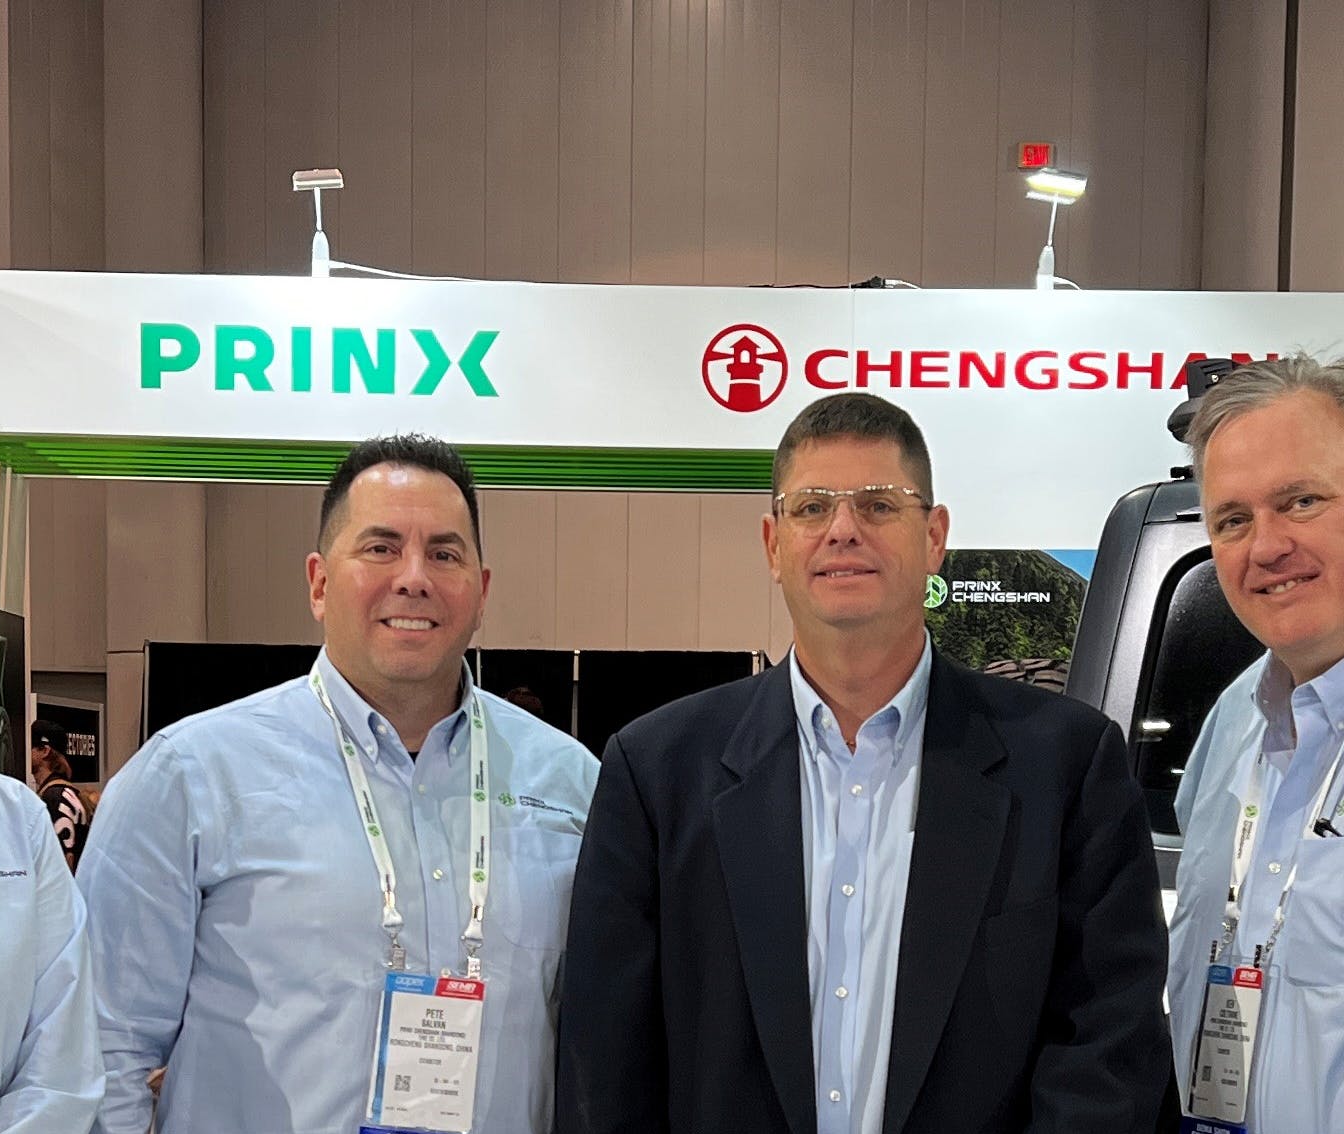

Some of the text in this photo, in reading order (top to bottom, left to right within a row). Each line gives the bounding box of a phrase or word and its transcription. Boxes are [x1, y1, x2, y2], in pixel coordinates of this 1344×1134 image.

[140, 322, 500, 398] PRINX
[952, 580, 1002, 592] PRINX
[952, 592, 1051, 603] CHENGSHAN
[425, 1008, 444, 1020] PETE
